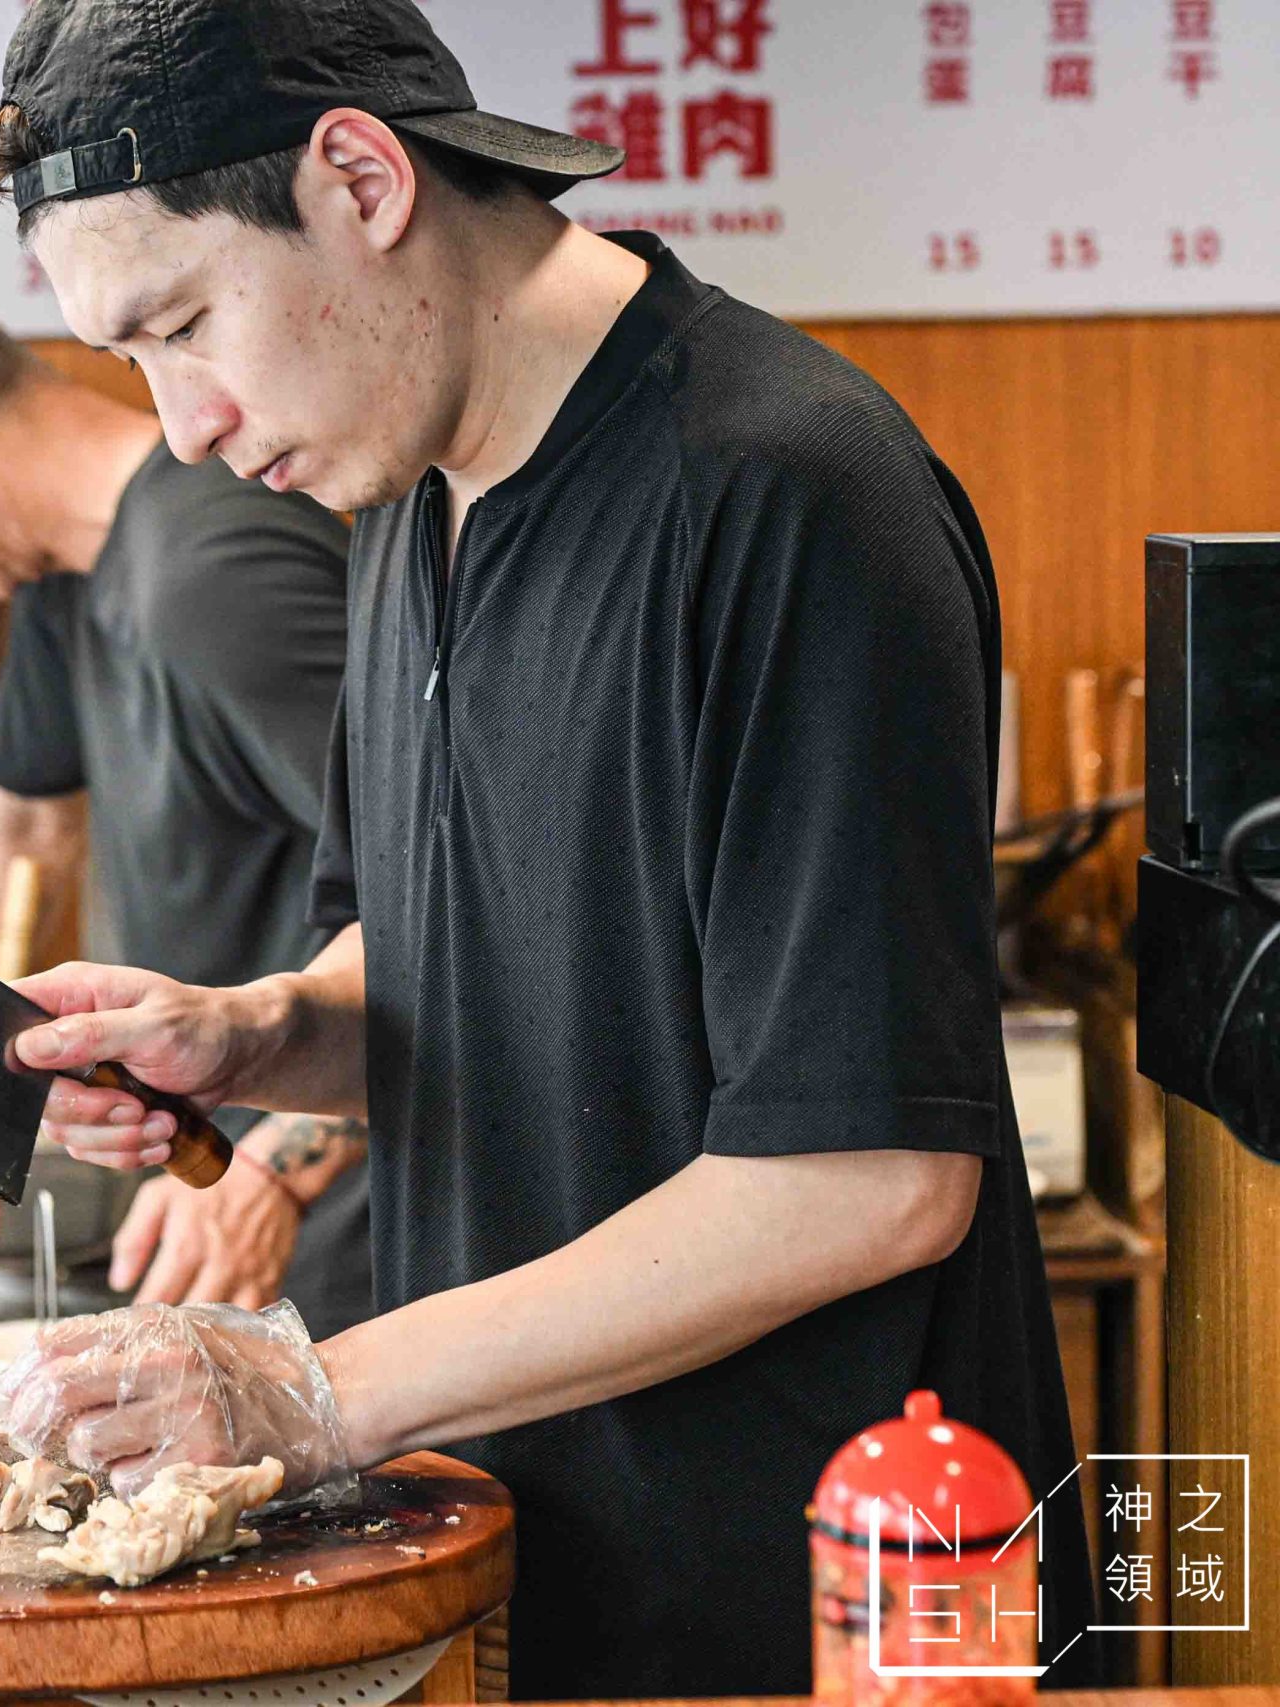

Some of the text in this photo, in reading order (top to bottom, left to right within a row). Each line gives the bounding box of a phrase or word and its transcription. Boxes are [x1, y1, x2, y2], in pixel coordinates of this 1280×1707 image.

[572, 0, 772, 75] 上好
[571, 90, 772, 181] 雞肉
[930, 233, 979, 271] 15
[1048, 231, 1097, 270] 15
[1170, 230, 1219, 267] 10
